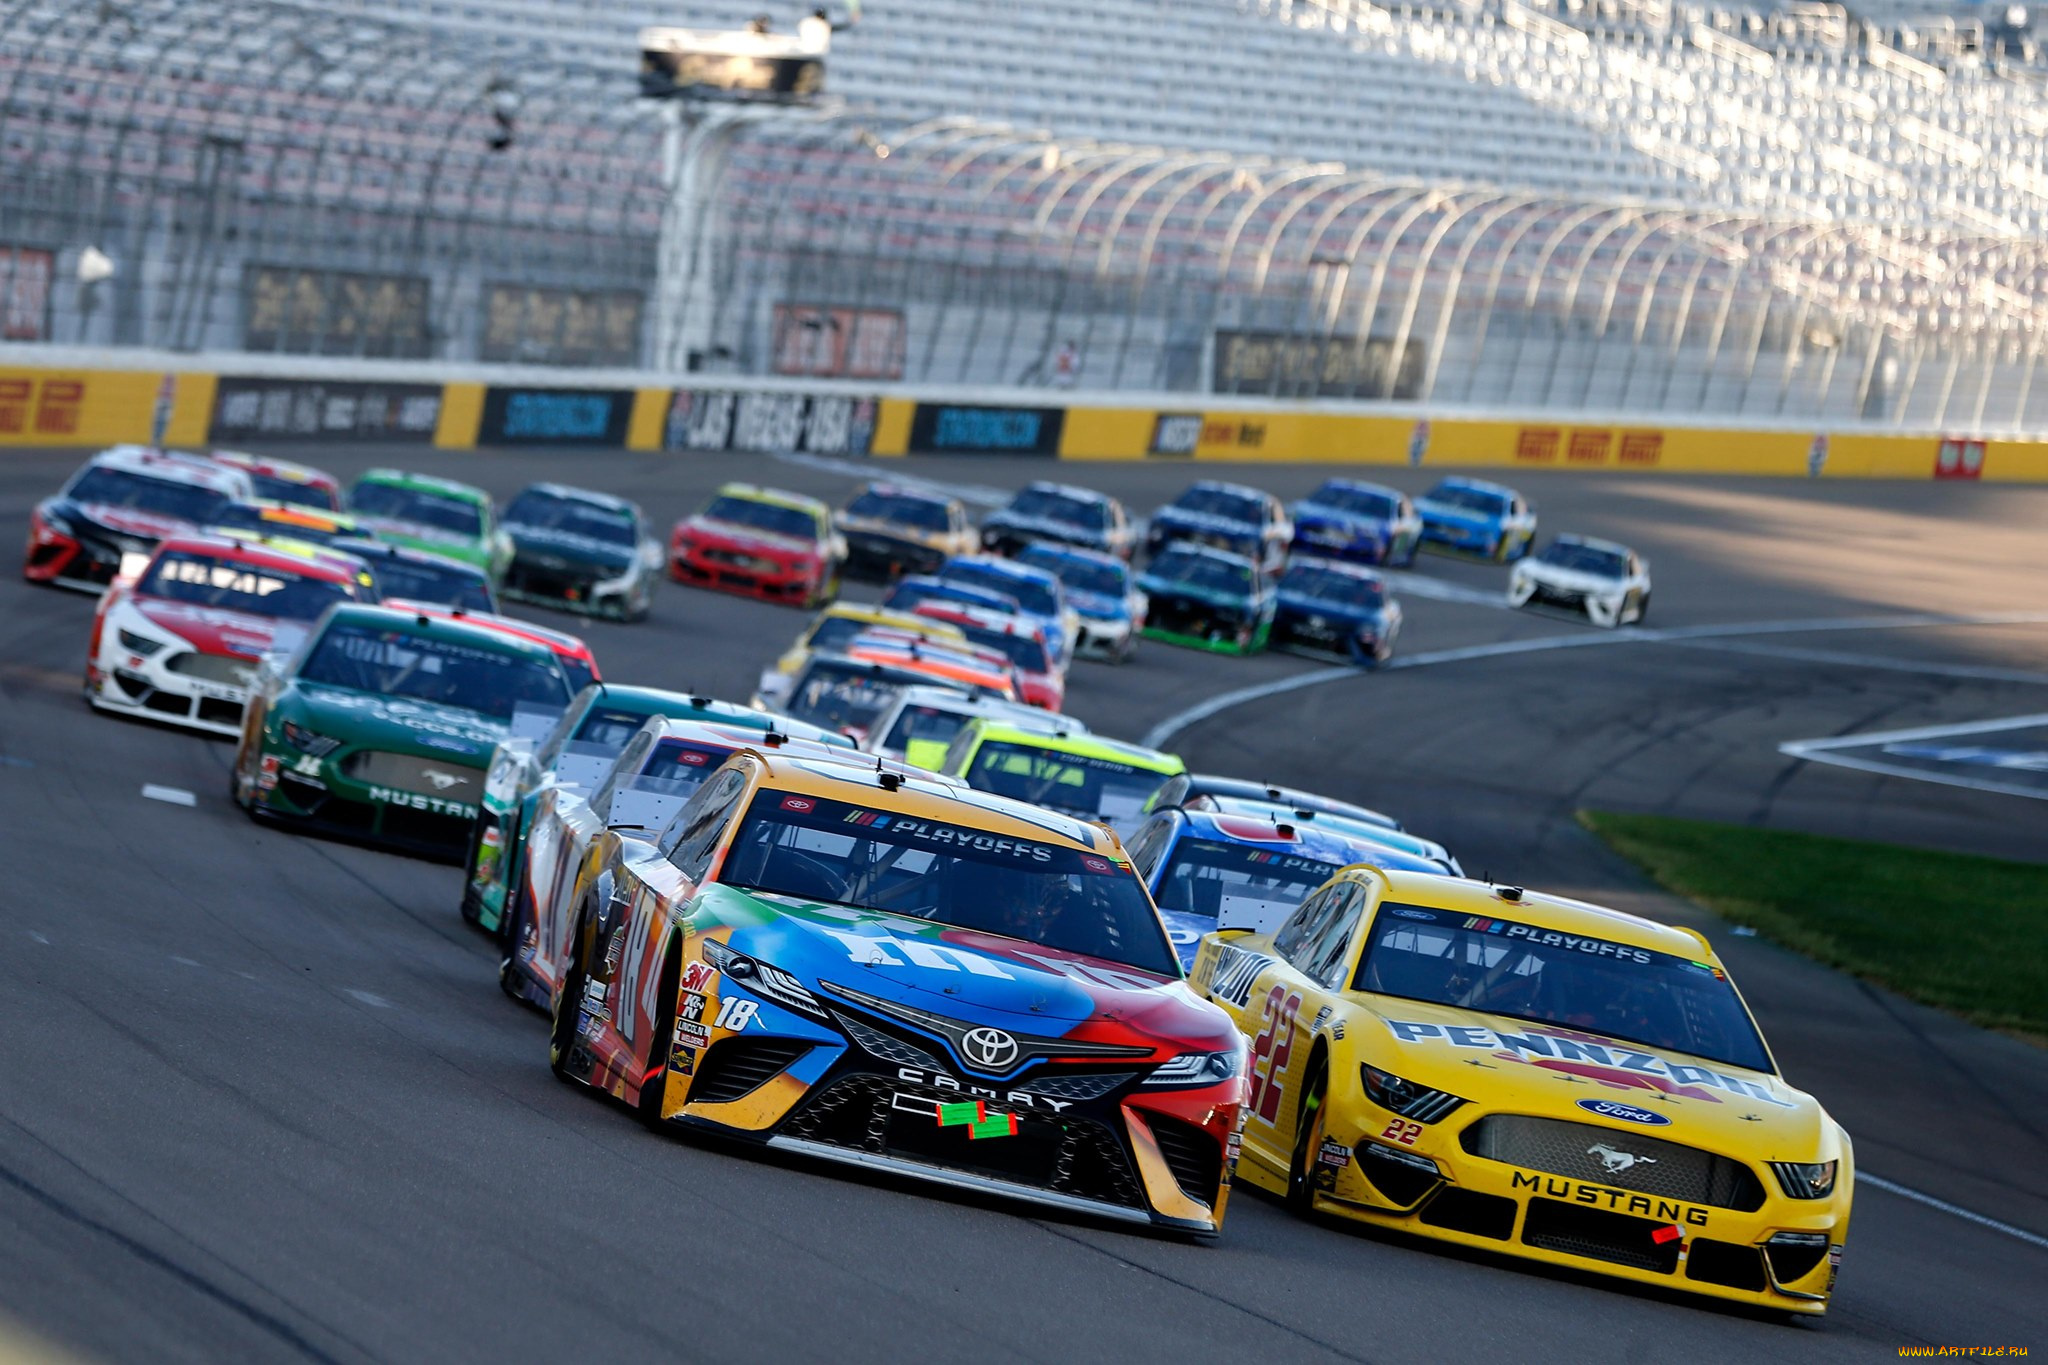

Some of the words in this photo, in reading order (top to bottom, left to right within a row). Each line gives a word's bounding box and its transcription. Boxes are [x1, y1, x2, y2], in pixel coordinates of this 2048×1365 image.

[368, 786, 479, 819] MUSTAN
[892, 820, 1052, 863] PLAYOFFS
[1507, 924, 1652, 965] PLAYOFFS
[681, 963, 715, 992] 3M
[677, 1020, 704, 1036] LINCOLN
[713, 995, 759, 1032] 18
[681, 1033, 705, 1047] WELDERS
[1383, 1018, 1792, 1108] PENNZOIL
[898, 1067, 1073, 1113] CAMRY
[1593, 1099, 1655, 1123] Ford
[1380, 1117, 1424, 1146] 22
[1511, 1170, 1709, 1227] MUSTANG
